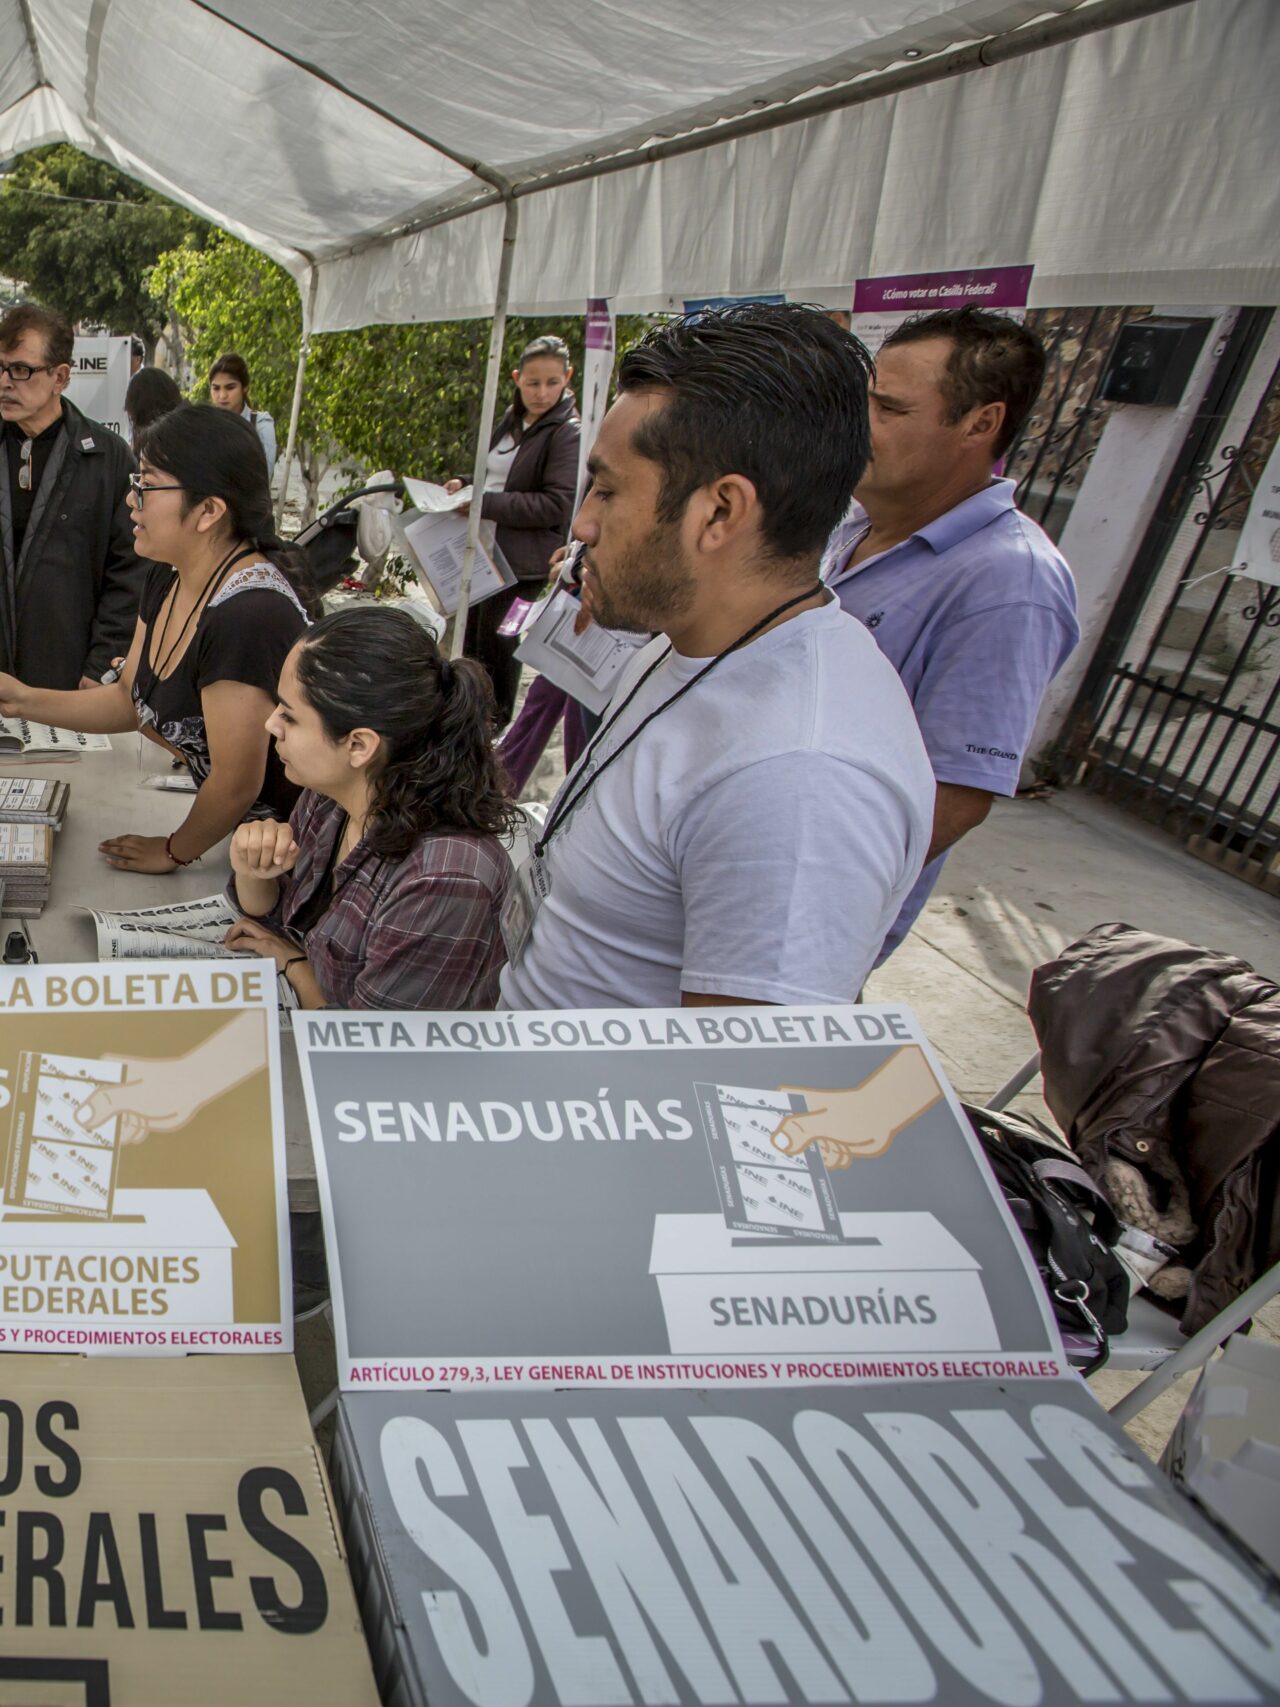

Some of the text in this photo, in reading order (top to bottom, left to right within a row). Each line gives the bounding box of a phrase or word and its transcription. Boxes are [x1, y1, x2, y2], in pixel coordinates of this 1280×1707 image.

[882, 282, 998, 300] ¿Cómo votar en Casilla Federal?
[80, 357, 108, 370] INE
[45, 973, 199, 1007] BOLETA
[210, 971, 264, 1004] DE
[307, 1014, 913, 1051] META AQUÍ SOLO LA BOLETA DE
[333, 1087, 694, 1142] SENADURÍAS
[54, 1120, 74, 1138] INE
[38, 1143, 59, 1160] INE
[752, 1146, 776, 1162] INE
[77, 1154, 98, 1172] INE
[744, 1168, 769, 1185] INE
[60, 1178, 80, 1196] INE
[788, 1179, 812, 1196] INE
[778, 1202, 804, 1220] INE
[709, 1288, 938, 1326] SENADURÍAS
[10, 1328, 20, 1342] Y
[24, 1328, 167, 1345] PROCEDIMIENTOS
[171, 1331, 282, 1346] ELECTORALES
[350, 1360, 1060, 1384] ARTÍCULO 279,3, LEY GENERAL DE INSTITUCIONES Y PROCEDIMIENTOS ELECTORALES
[380, 1404, 1280, 1707] SENADORES
